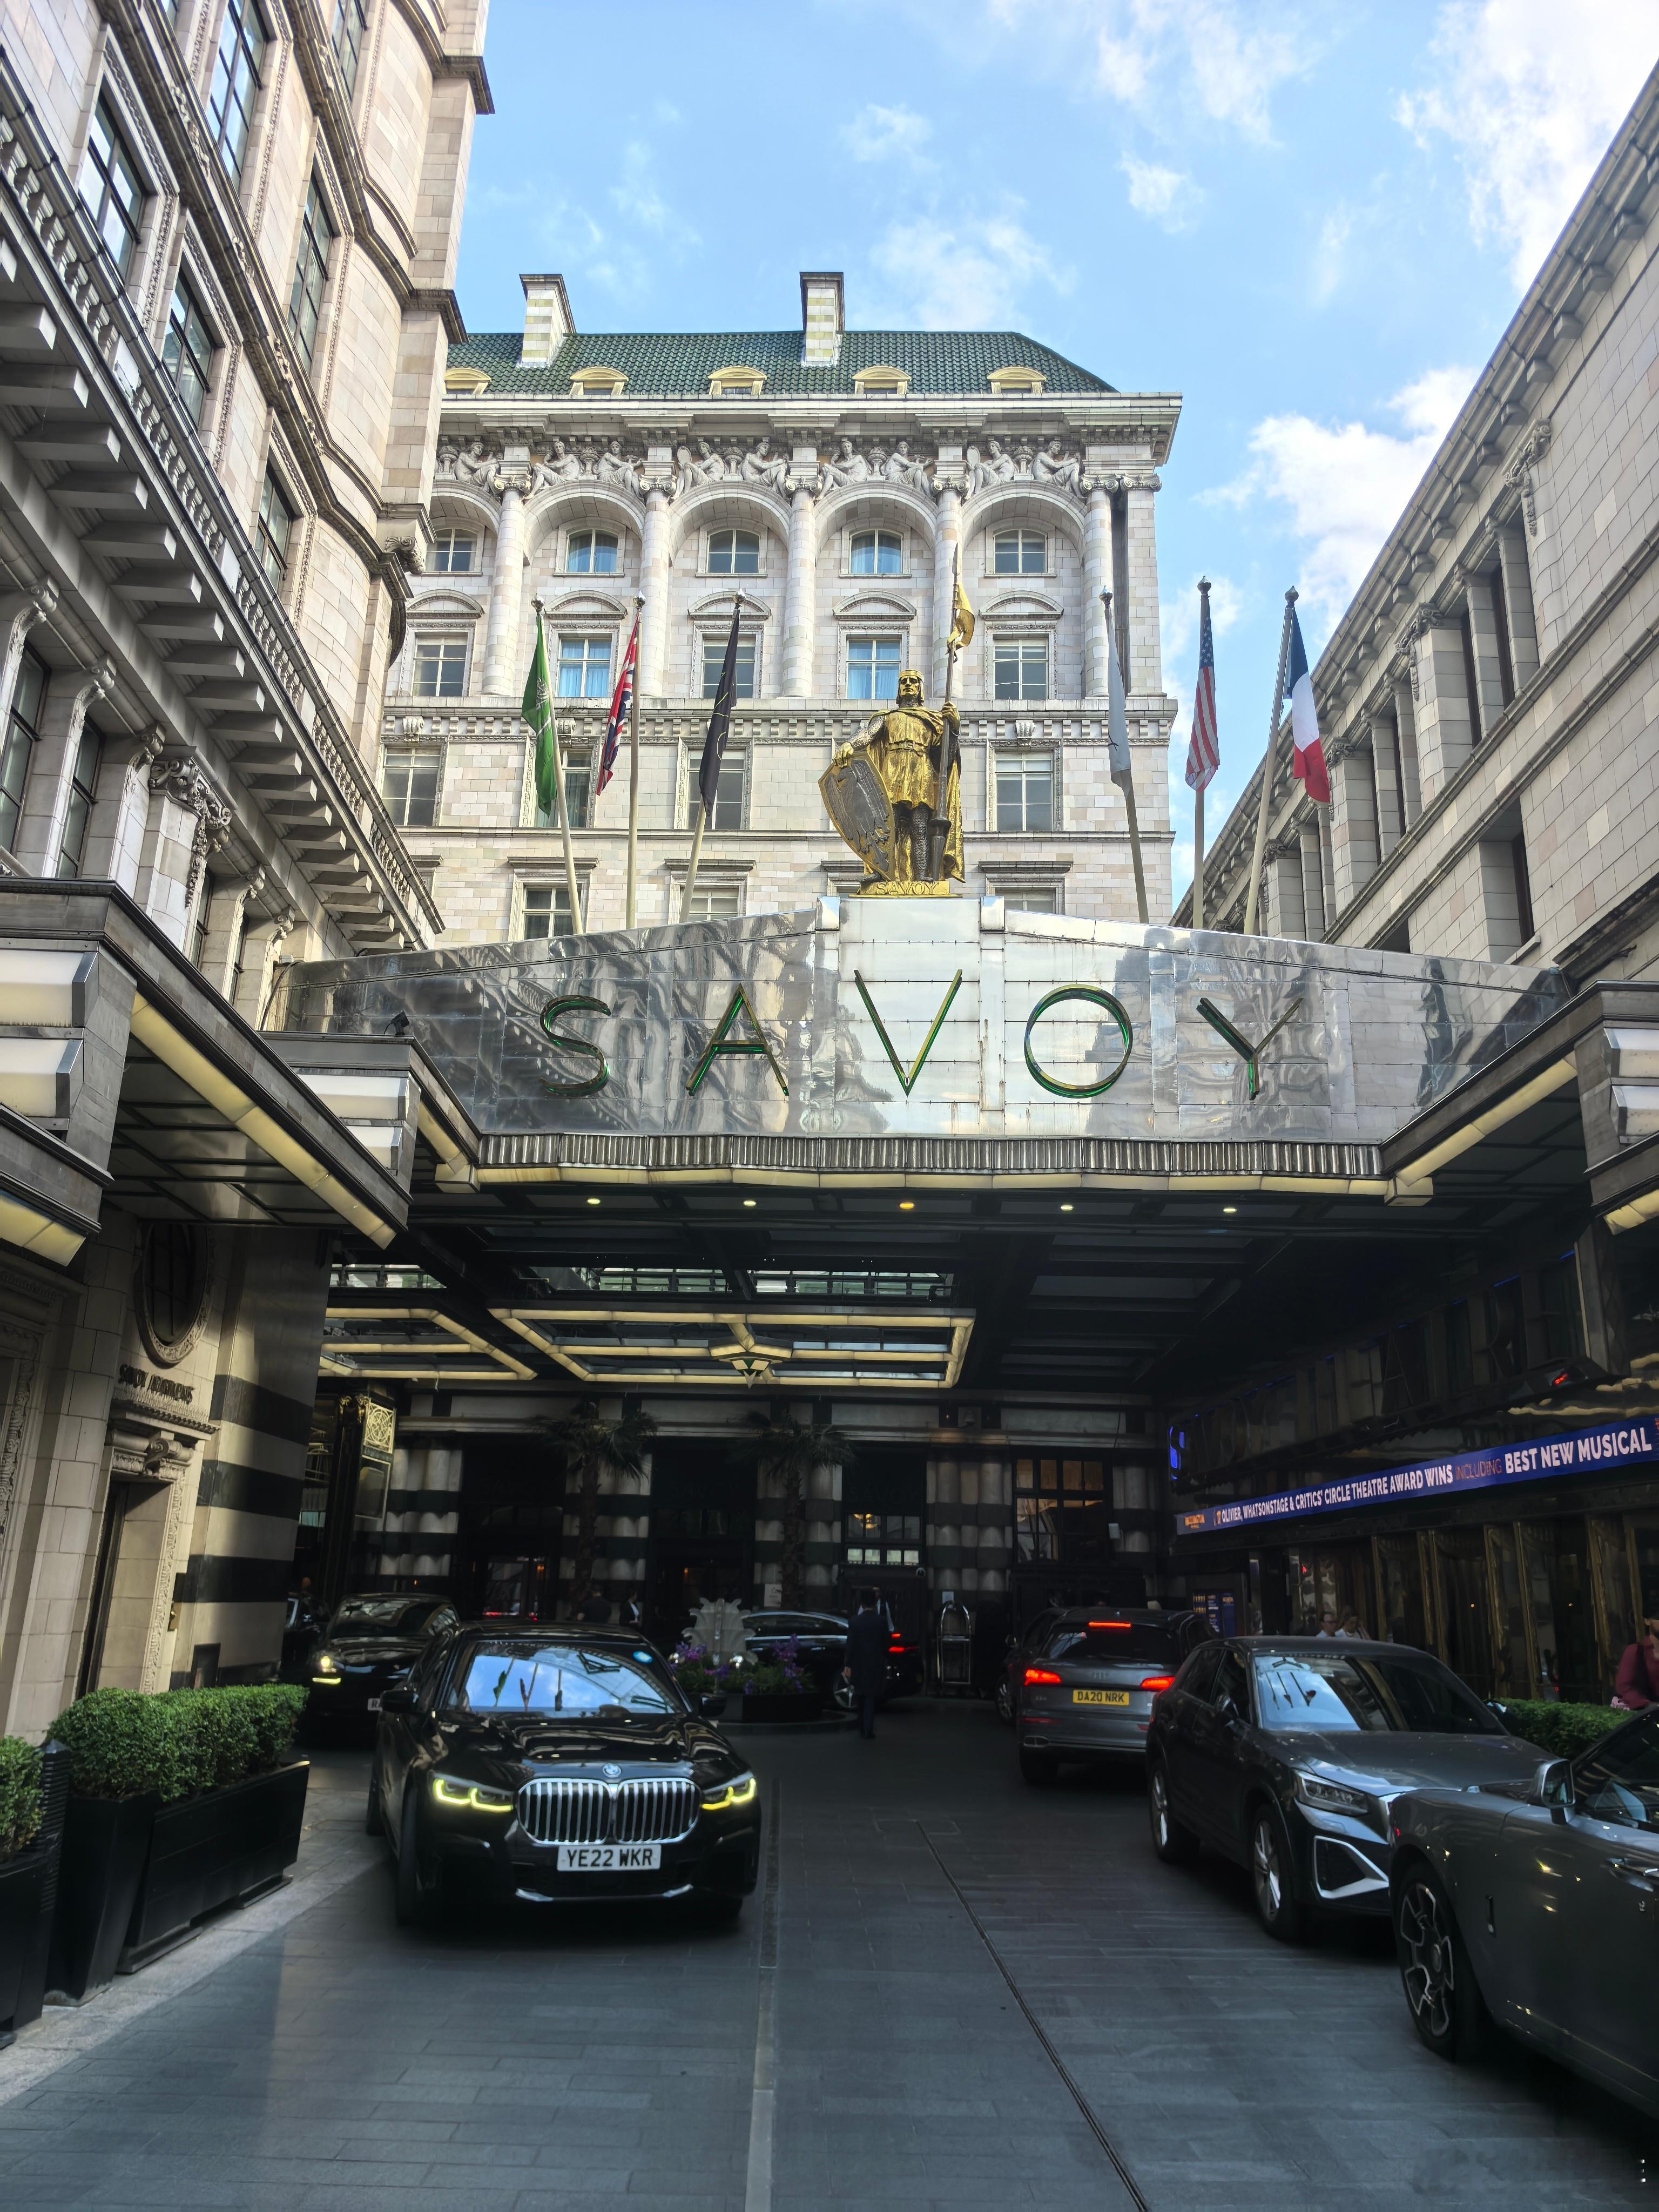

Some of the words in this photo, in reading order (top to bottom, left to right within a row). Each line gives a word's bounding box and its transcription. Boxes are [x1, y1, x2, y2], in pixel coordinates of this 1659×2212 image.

[876, 881, 939, 895] SAVOY
[539, 969, 1304, 1101] SAVOY
[1243, 1496, 1287, 1519] WHATSONSTAGE
[1290, 1498, 1294, 1510] &
[1324, 1484, 1351, 1504] CIRCLE
[1351, 1476, 1388, 1499] THEATRE
[1390, 1470, 1423, 1493] AWARD
[1424, 1464, 1453, 1487] WINS
[1455, 1458, 1502, 1480] INCLUDING
[1505, 1448, 1537, 1474] BEST
[1540, 1441, 1574, 1468] NEW
[1577, 1427, 1653, 1462] MUSICAL
[1077, 1691, 1102, 1702] DA20
[1105, 1692, 1124, 1703] NRK
[567, 1849, 613, 1867] YE22
[619, 1849, 653, 1867] WKR
